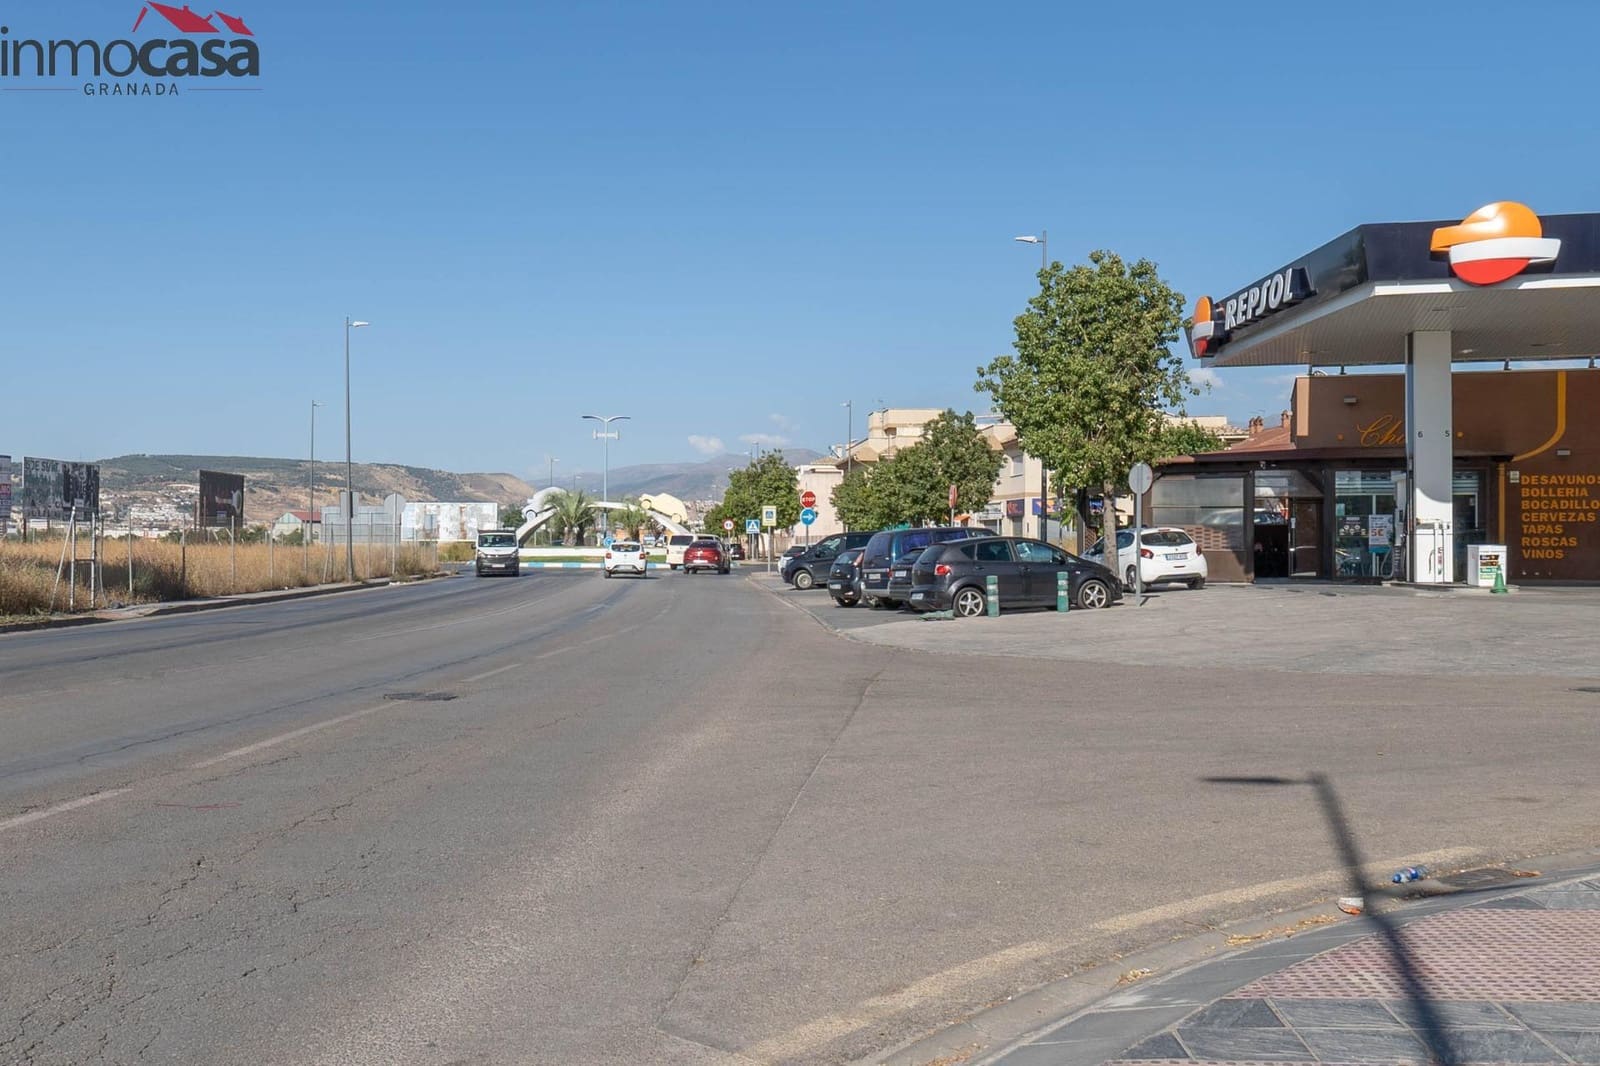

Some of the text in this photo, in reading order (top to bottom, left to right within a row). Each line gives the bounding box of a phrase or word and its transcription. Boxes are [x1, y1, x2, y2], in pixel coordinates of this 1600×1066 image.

[1224, 267, 1293, 331] REPSOL
[1444, 430, 1450, 438] 5
[1521, 487, 1589, 497] BOLLERIA
[1521, 512, 1596, 522] CERVEZAS
[1522, 525, 1564, 534] TAPAS
[1521, 537, 1578, 547] ROSCAS
[1522, 549, 1565, 559] VINOS
